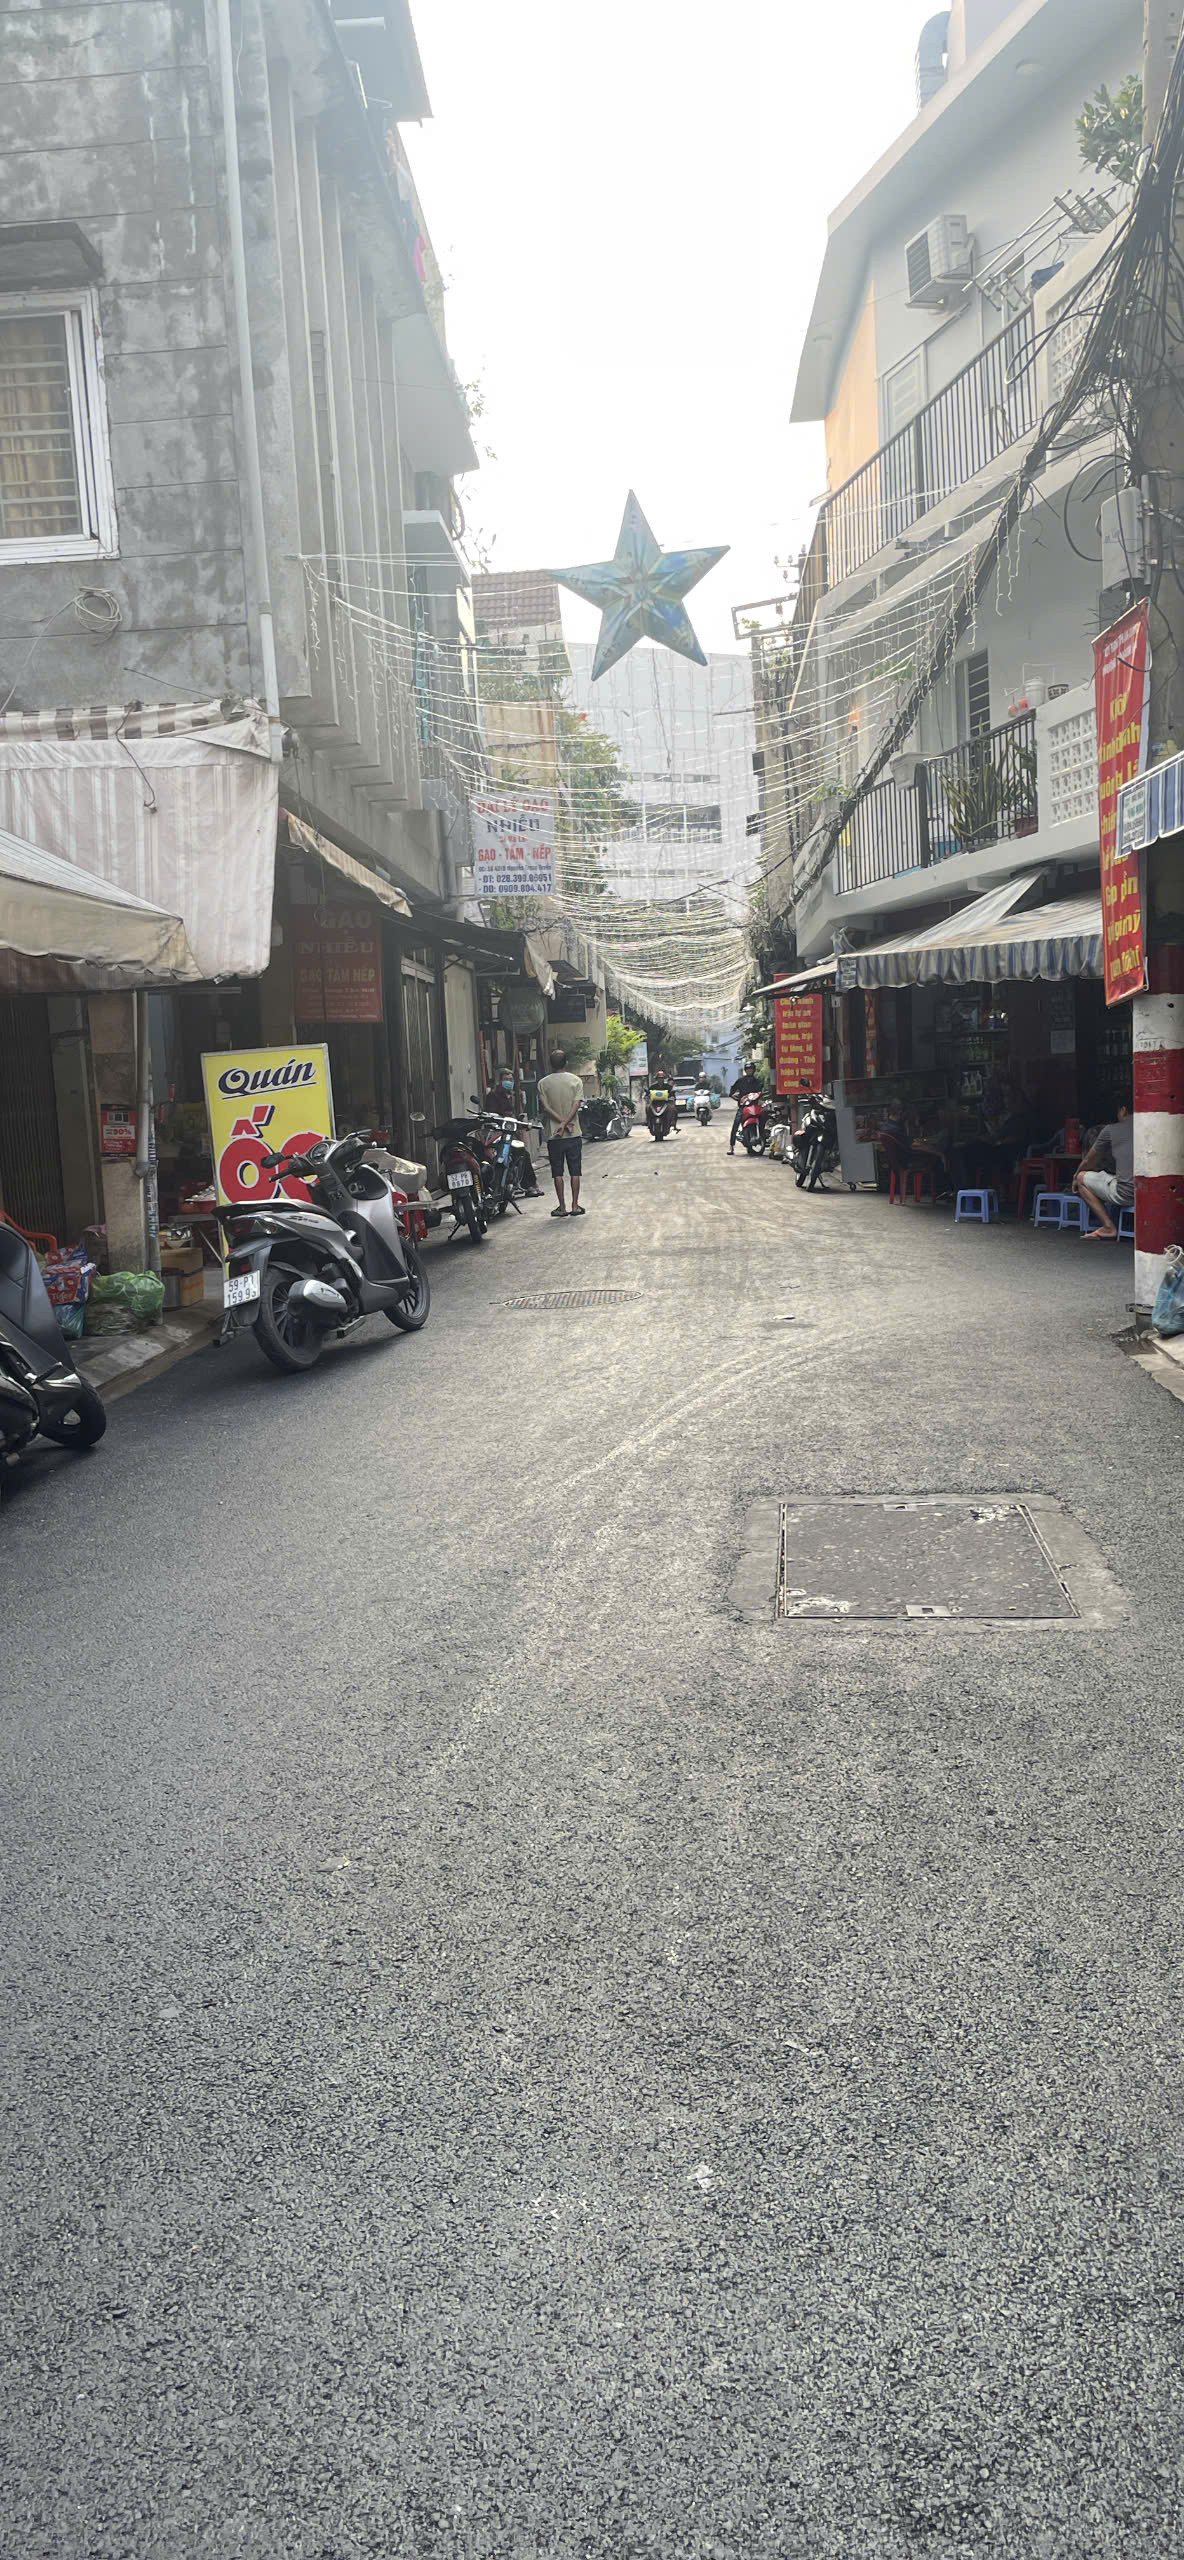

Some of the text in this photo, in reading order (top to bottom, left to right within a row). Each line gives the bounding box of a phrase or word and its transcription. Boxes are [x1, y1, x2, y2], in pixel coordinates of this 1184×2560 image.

[478, 847, 497, 863] GẠO
[505, 844, 524, 861] TẤM
[532, 843, 552, 860] NẾP
[218, 1058, 317, 1096] Quán
